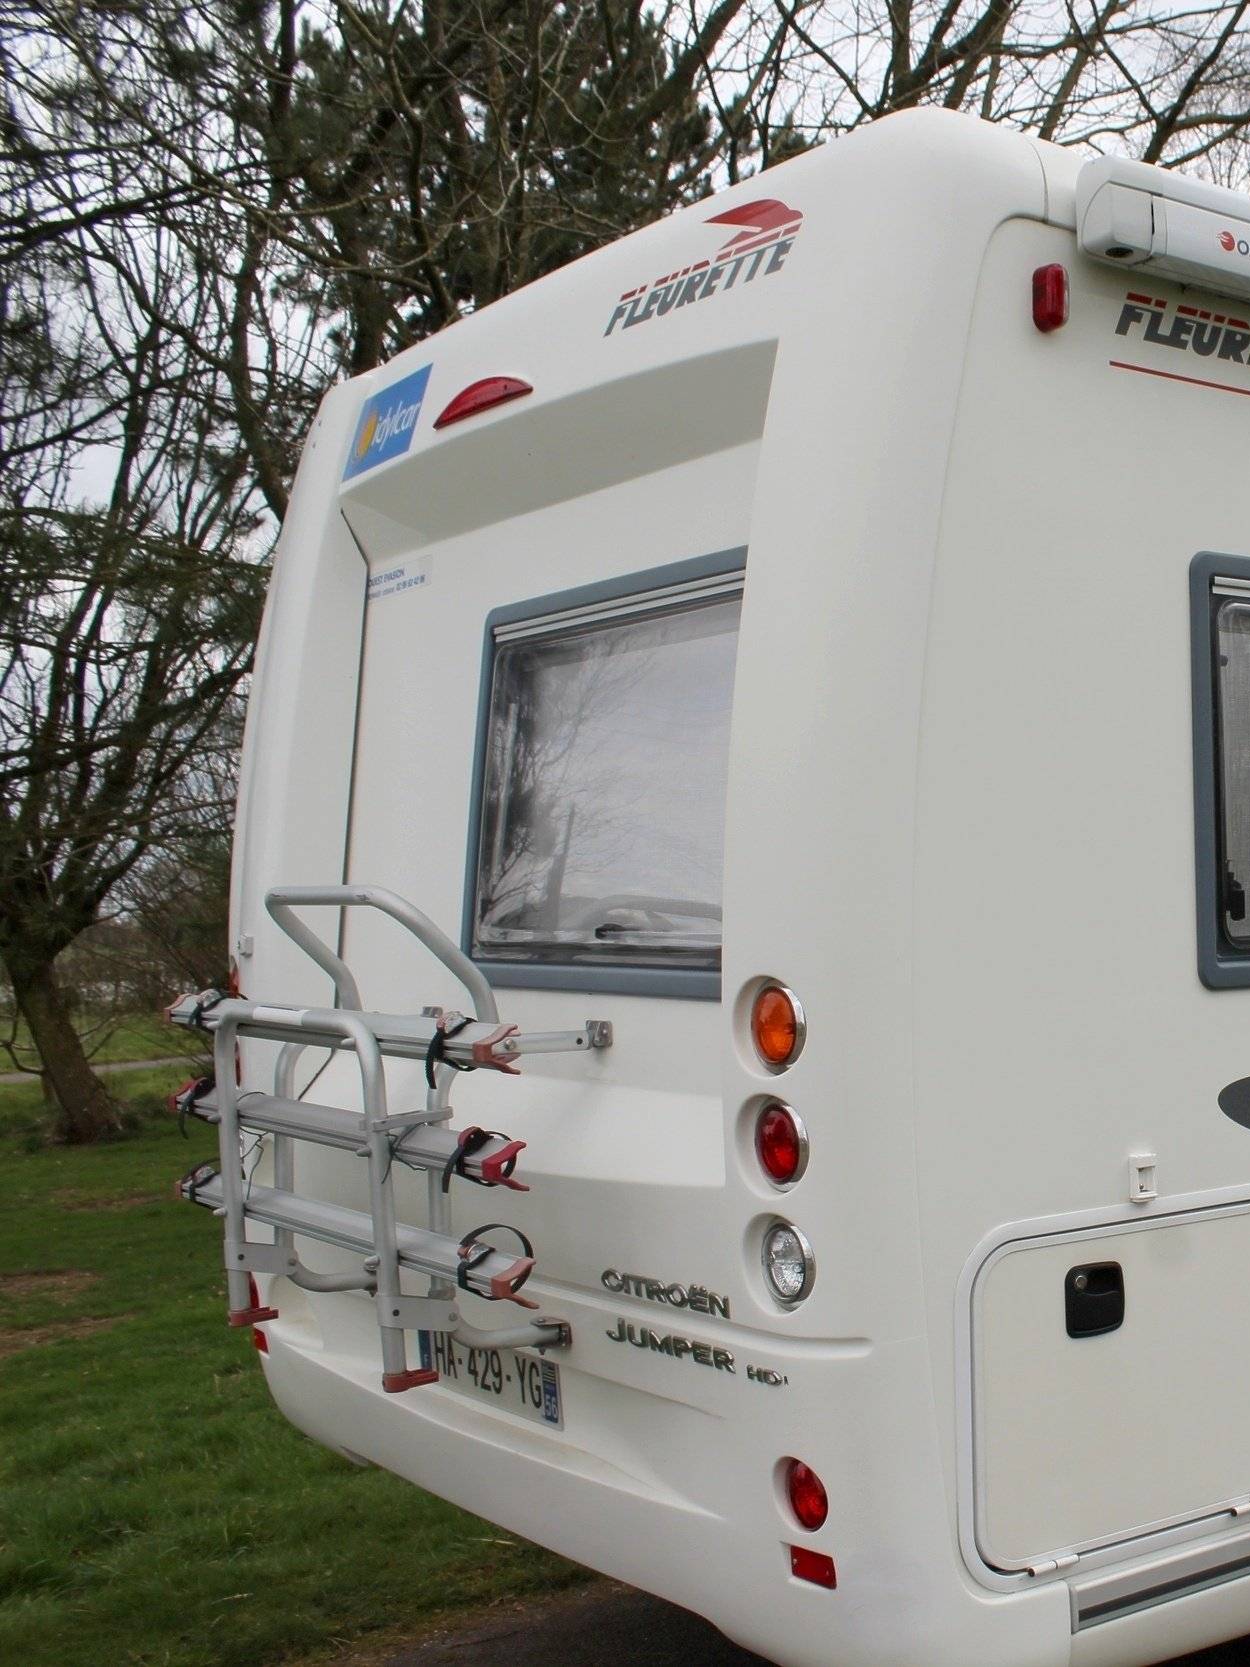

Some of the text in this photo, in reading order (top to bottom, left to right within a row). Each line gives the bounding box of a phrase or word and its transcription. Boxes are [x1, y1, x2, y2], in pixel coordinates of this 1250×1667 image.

[603, 223, 801, 338] FLEURETTE
[601, 1267, 731, 1319] CITROËN
[606, 1317, 737, 1375] JUMPER
